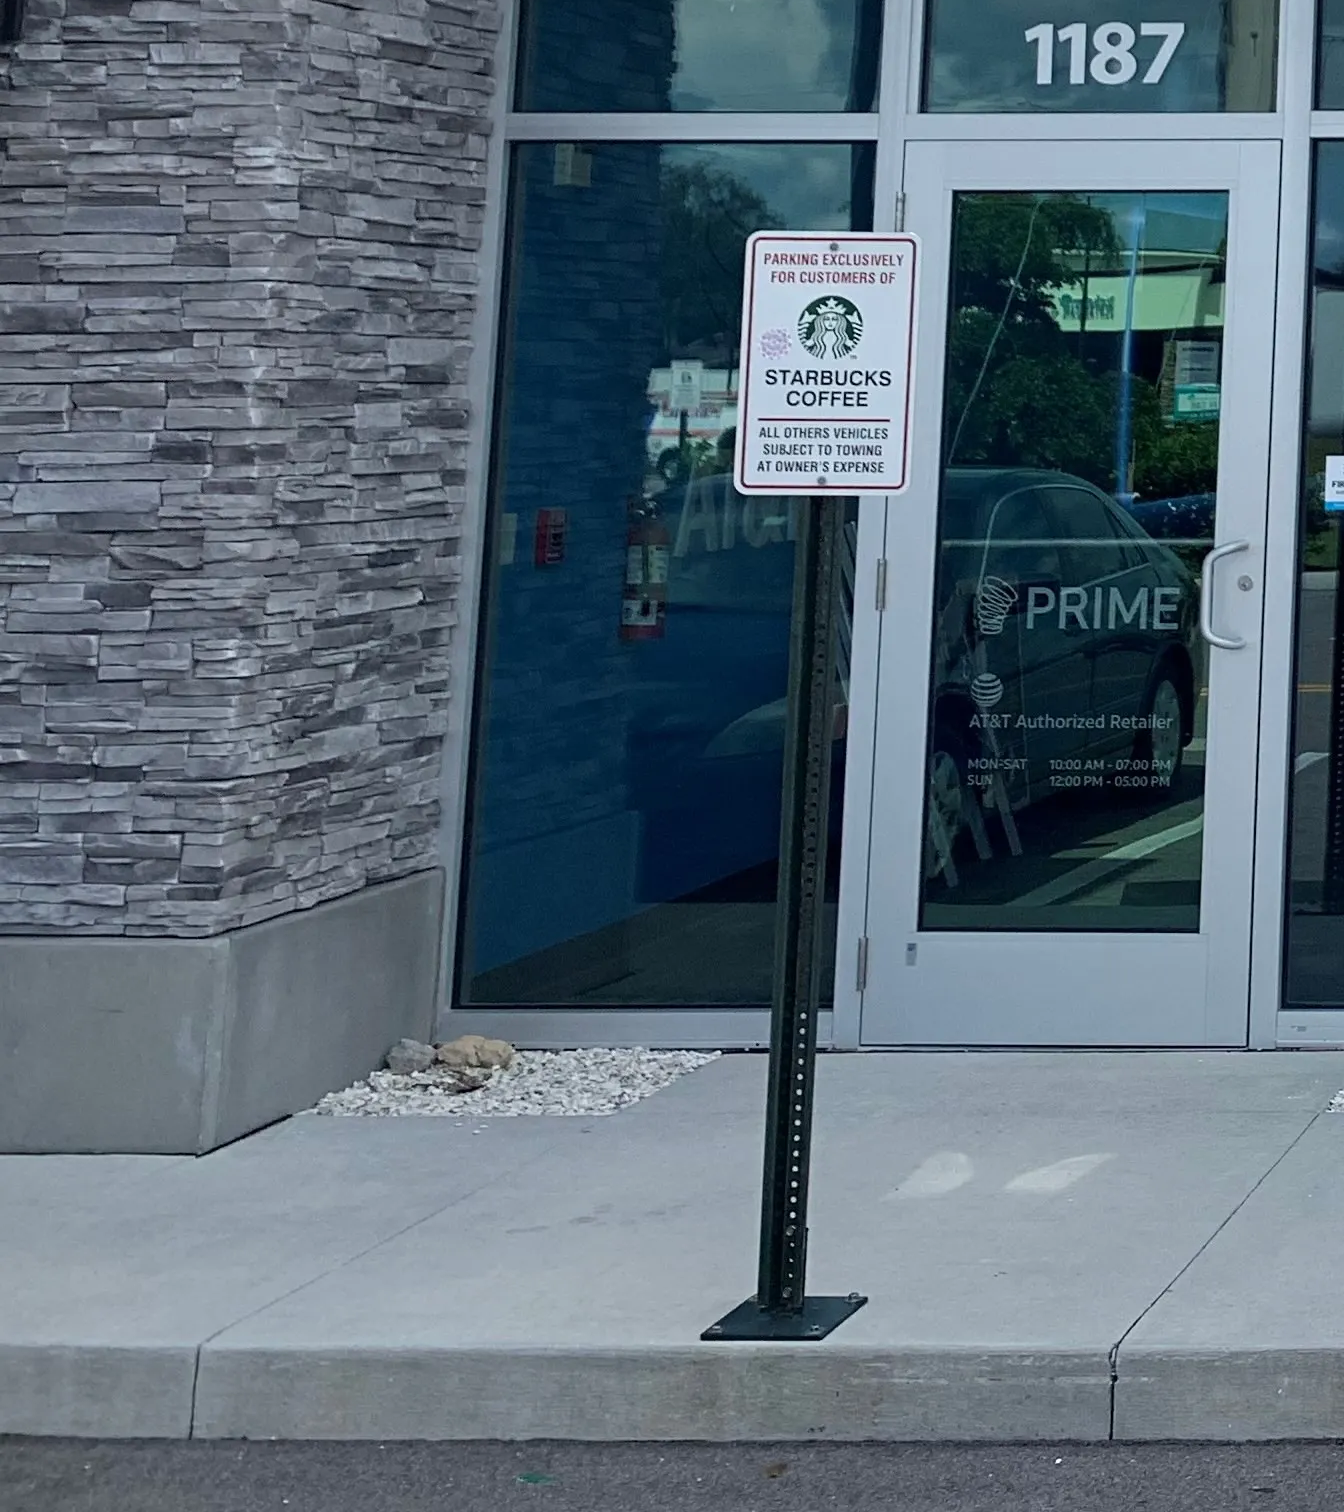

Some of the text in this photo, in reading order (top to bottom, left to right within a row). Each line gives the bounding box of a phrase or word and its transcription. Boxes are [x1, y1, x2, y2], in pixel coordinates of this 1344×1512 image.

[1024, 22, 1185, 85] 1187
[763, 253, 904, 267] PARKING EXCLUSIVELY
[770, 270, 896, 285] FOR CUSTOMERS OF
[765, 369, 892, 387] STARBUCKS
[786, 390, 869, 407] COFFEE
[758, 426, 889, 440] ALL OTHERS VEHICLES
[762, 443, 883, 457] SUBJECT TO TOWING
[756, 460, 884, 473] AT OWNER'S EXPENSE
[1026, 586, 1181, 630] PRIME
[968, 713, 1174, 729] AT&T Authorized Retailer
[967, 758, 1028, 771] MON-SAT
[1049, 759, 1082, 770] 10:00
[1083, 759, 1105, 770] AM
[1115, 759, 1149, 771] 07:00
[1151, 759, 1172, 770] PM
[967, 773, 994, 786] SUN
[1049, 775, 1081, 787] 12:00
[1083, 775, 1103, 787] PM
[1114, 775, 1149, 787] 05:00
[1150, 775, 1171, 787] PM
